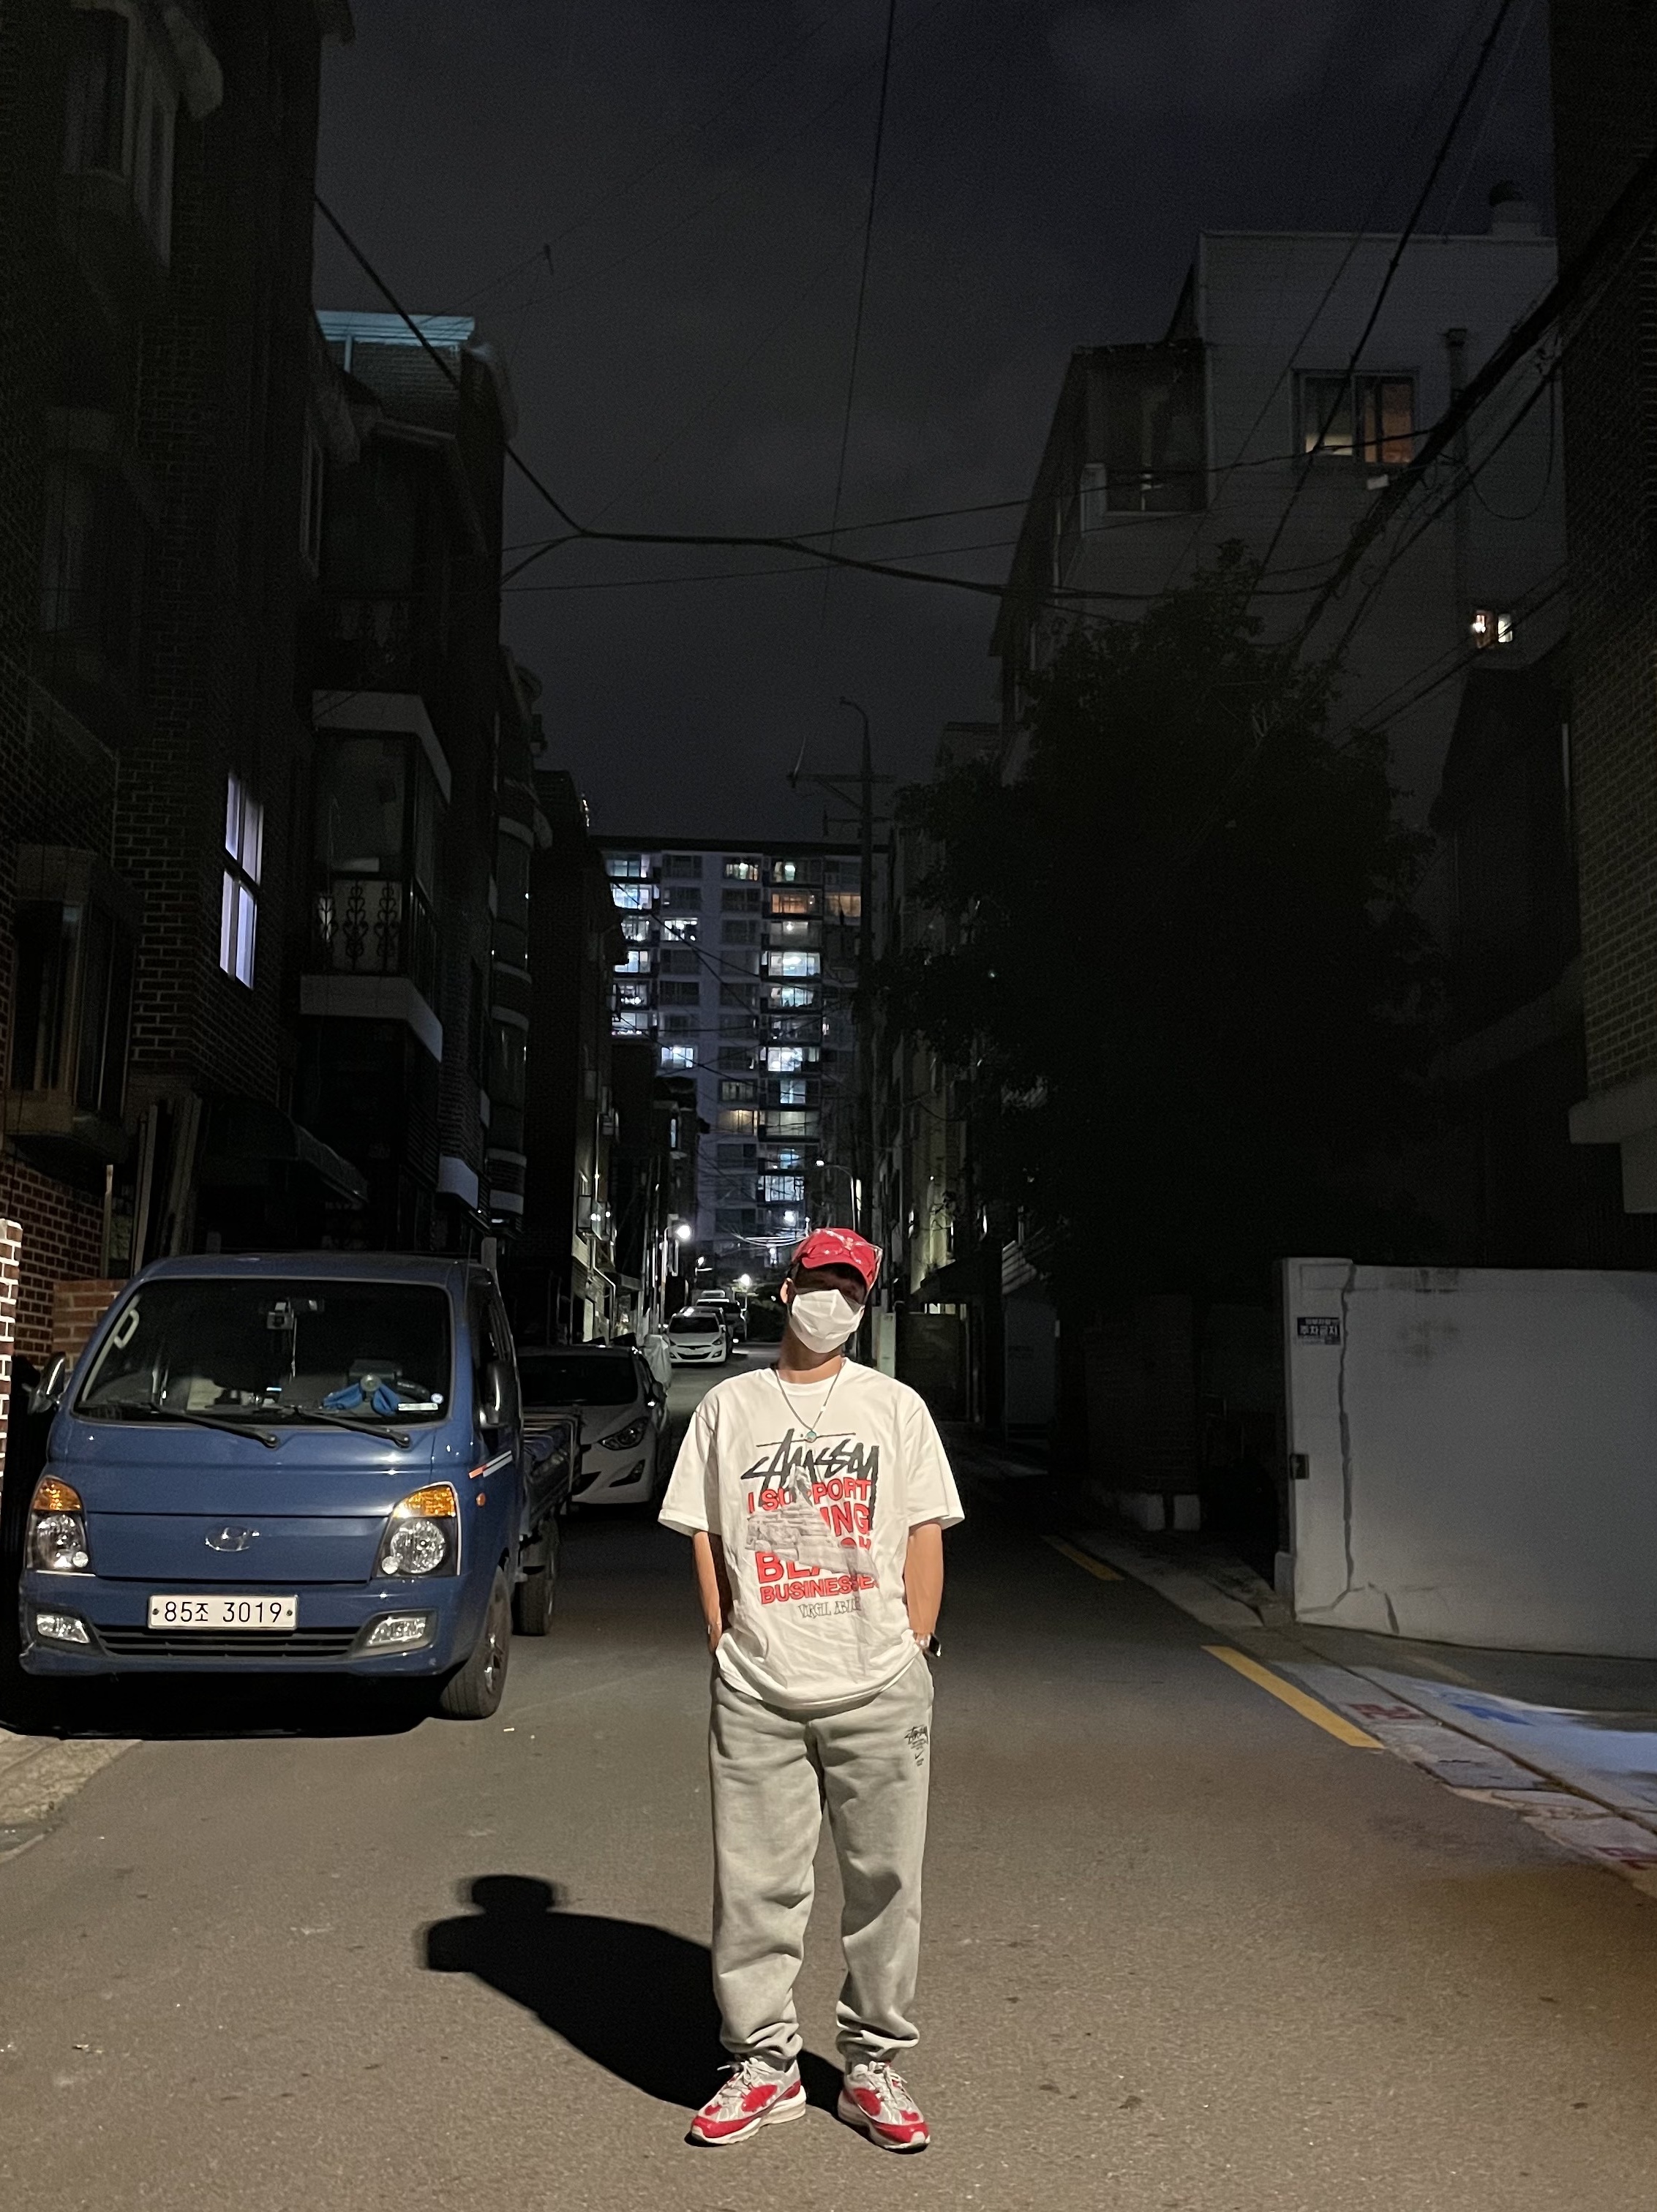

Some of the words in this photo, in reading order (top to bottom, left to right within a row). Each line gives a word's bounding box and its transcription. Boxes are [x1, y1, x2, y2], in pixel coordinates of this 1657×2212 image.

[748, 1492, 756, 1513] I
[761, 1477, 872, 1512] SUPORT
[164, 1601, 208, 1622] 85조
[222, 1602, 282, 1623] 3019
[798, 1602, 832, 1619] VIRGIL
